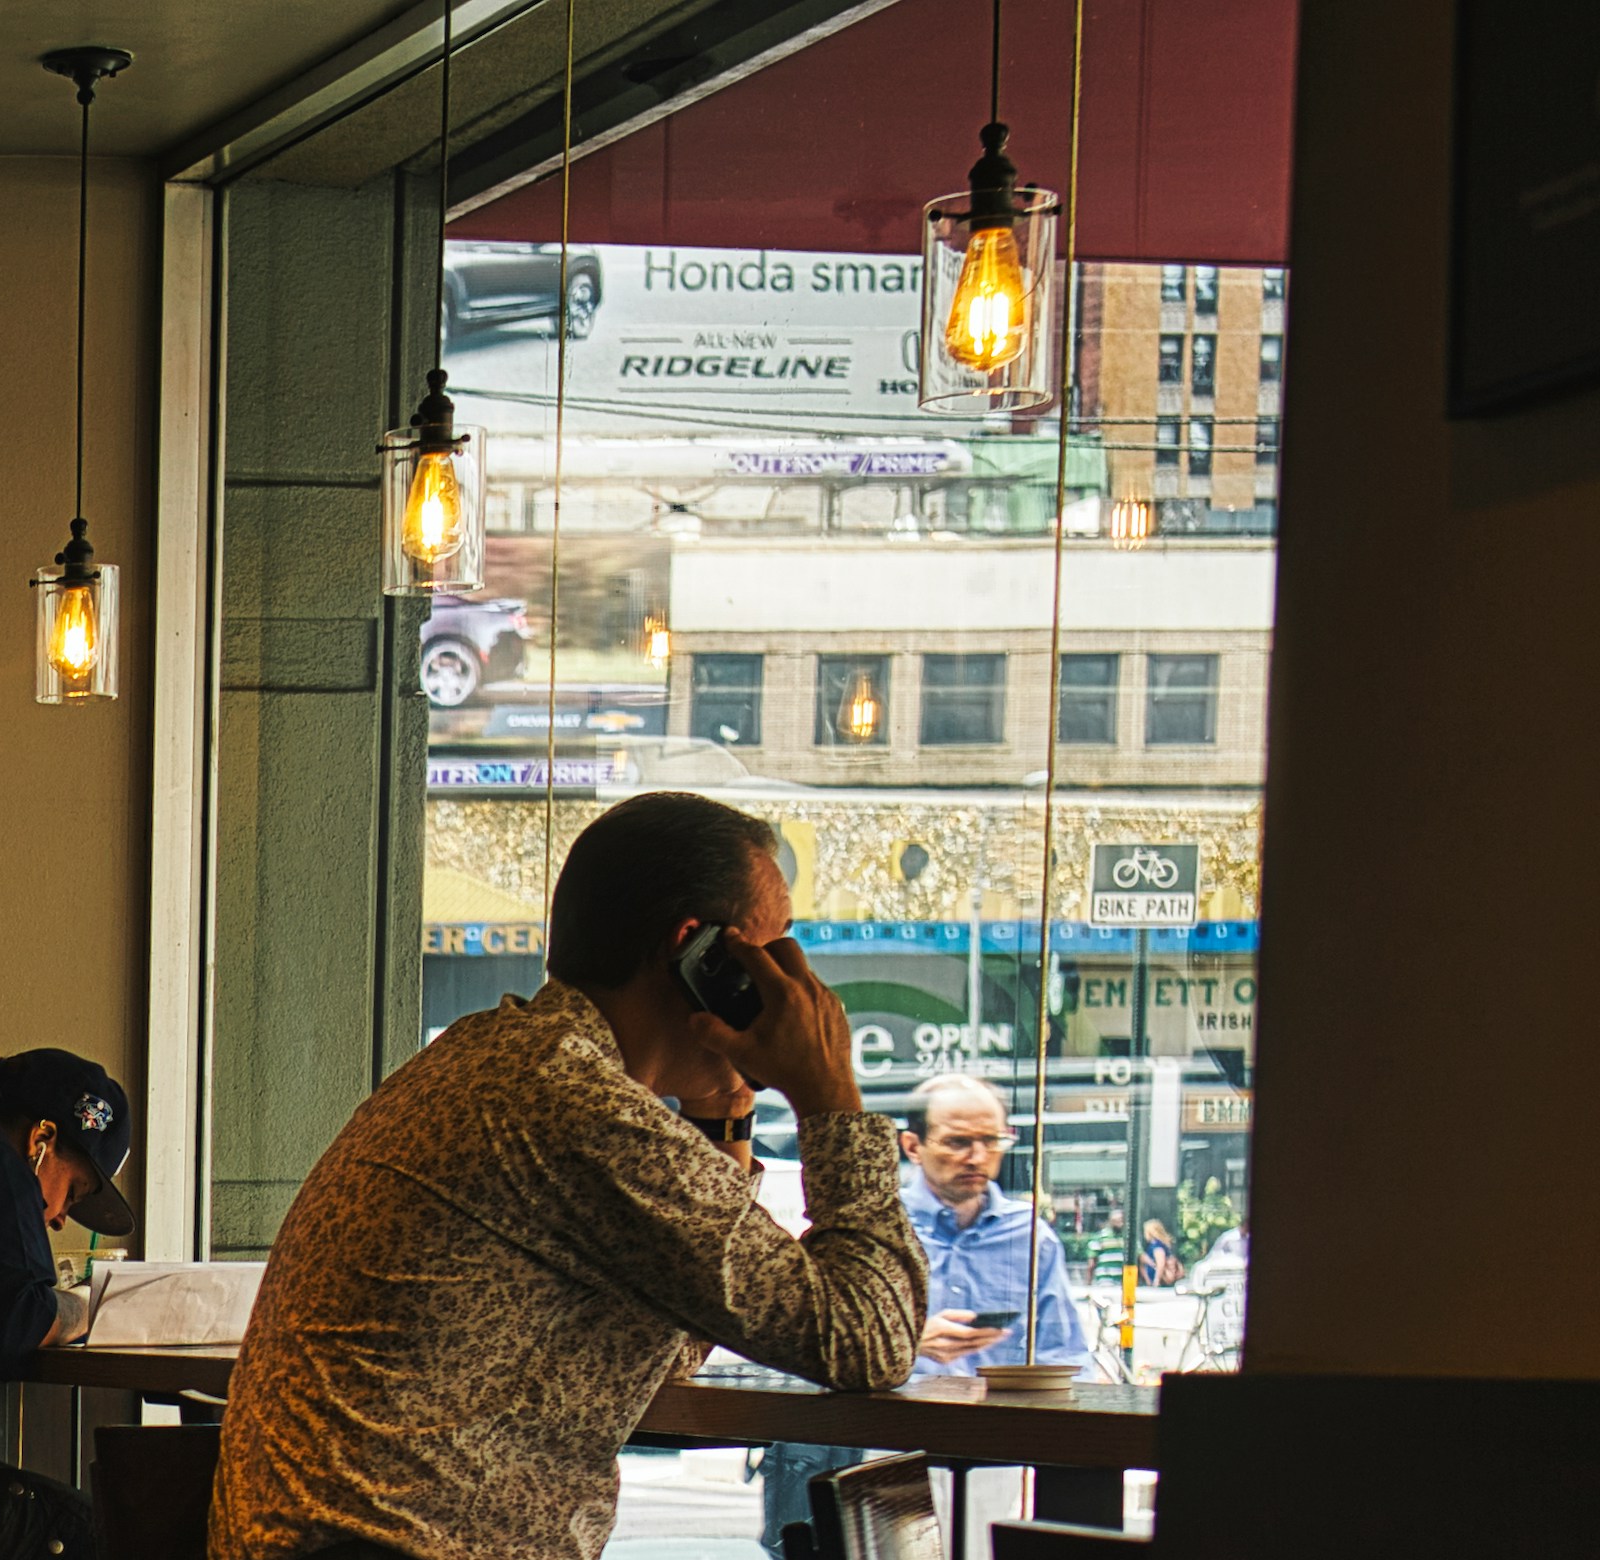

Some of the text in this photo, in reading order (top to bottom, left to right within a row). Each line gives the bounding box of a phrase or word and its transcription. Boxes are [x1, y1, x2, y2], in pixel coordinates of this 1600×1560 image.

[644, 250, 794, 293] Honda
[620, 355, 851, 379] RIDGELINE
[1099, 898, 1189, 918] BIKE PATH
[1084, 978, 1218, 1007] EMETT
[913, 1022, 1013, 1051] OPEN
